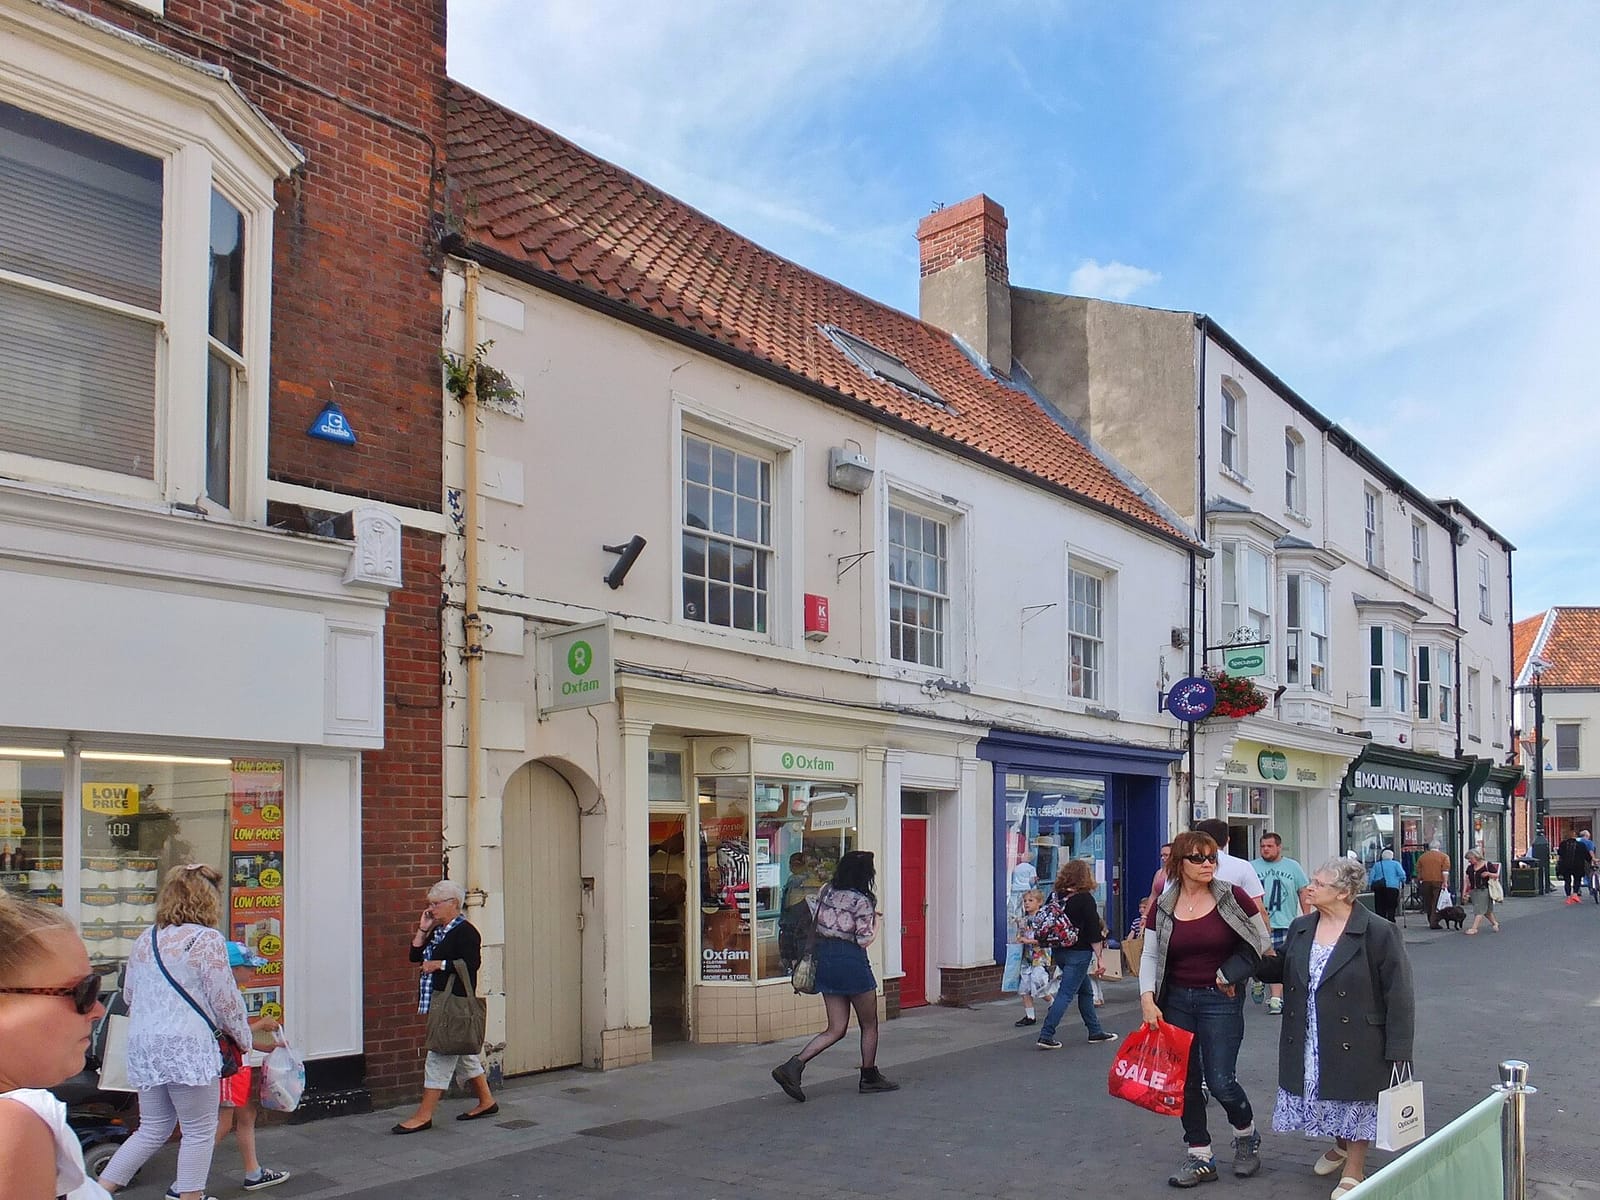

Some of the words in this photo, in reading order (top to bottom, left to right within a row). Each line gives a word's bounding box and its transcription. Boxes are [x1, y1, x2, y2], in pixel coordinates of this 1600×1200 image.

[818, 605, 827, 617] K
[562, 679, 599, 695] Oxfam
[796, 755, 834, 771] Oxfam
[1362, 773, 1407, 792] MOUNTAIN
[1409, 778, 1454, 797] WAREHOUSE
[92, 788, 128, 799] LOW
[92, 800, 128, 808] PRICE
[234, 828, 254, 840] LOW
[256, 827, 282, 840] PRICE
[1405, 831, 1417, 840] SALE
[234, 896, 254, 908] LOW
[256, 895, 282, 907] PRICE
[703, 948, 749, 960] Oxfam
[1116, 1060, 1167, 1090] SALE
